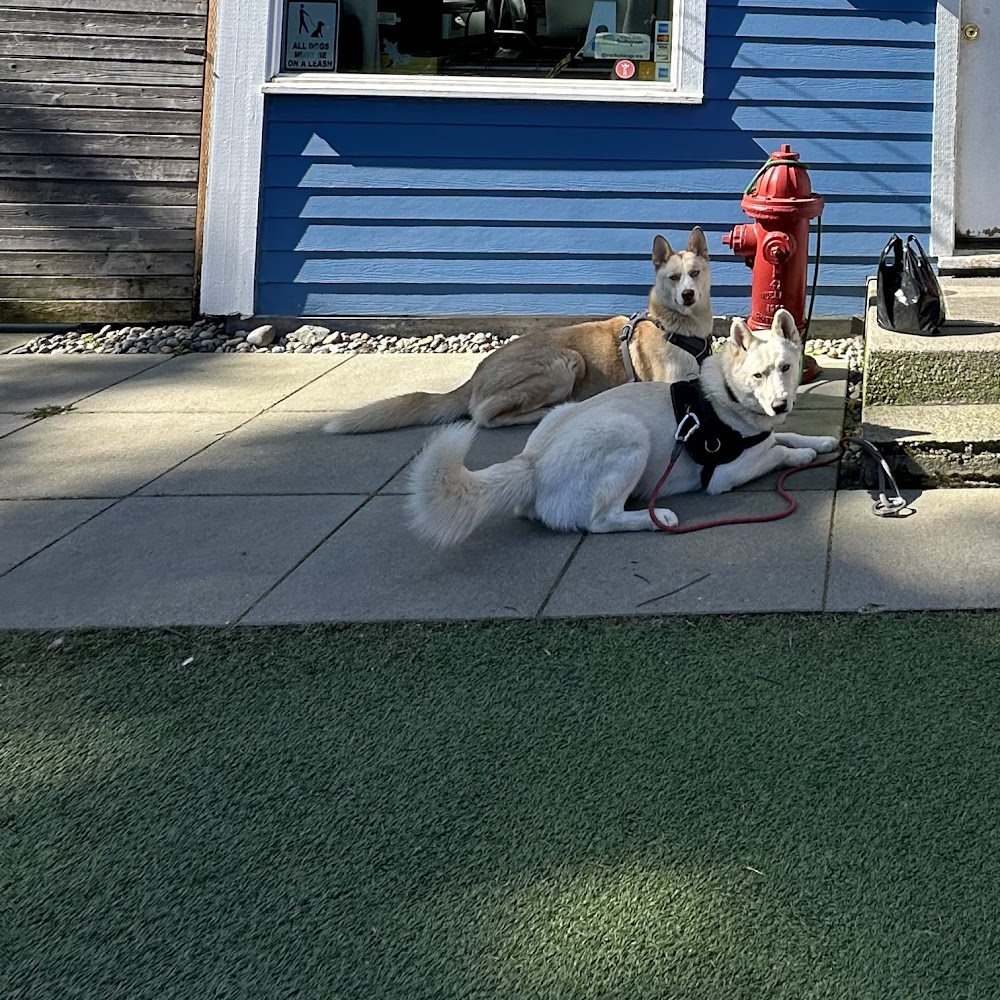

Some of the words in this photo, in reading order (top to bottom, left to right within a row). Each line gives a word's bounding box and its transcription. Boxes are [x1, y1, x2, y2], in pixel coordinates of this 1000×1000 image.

[308, 42, 329, 50] DOGS
[287, 59, 299, 67] ON
[300, 60, 306, 68] A
[308, 60, 333, 68] LEASH
